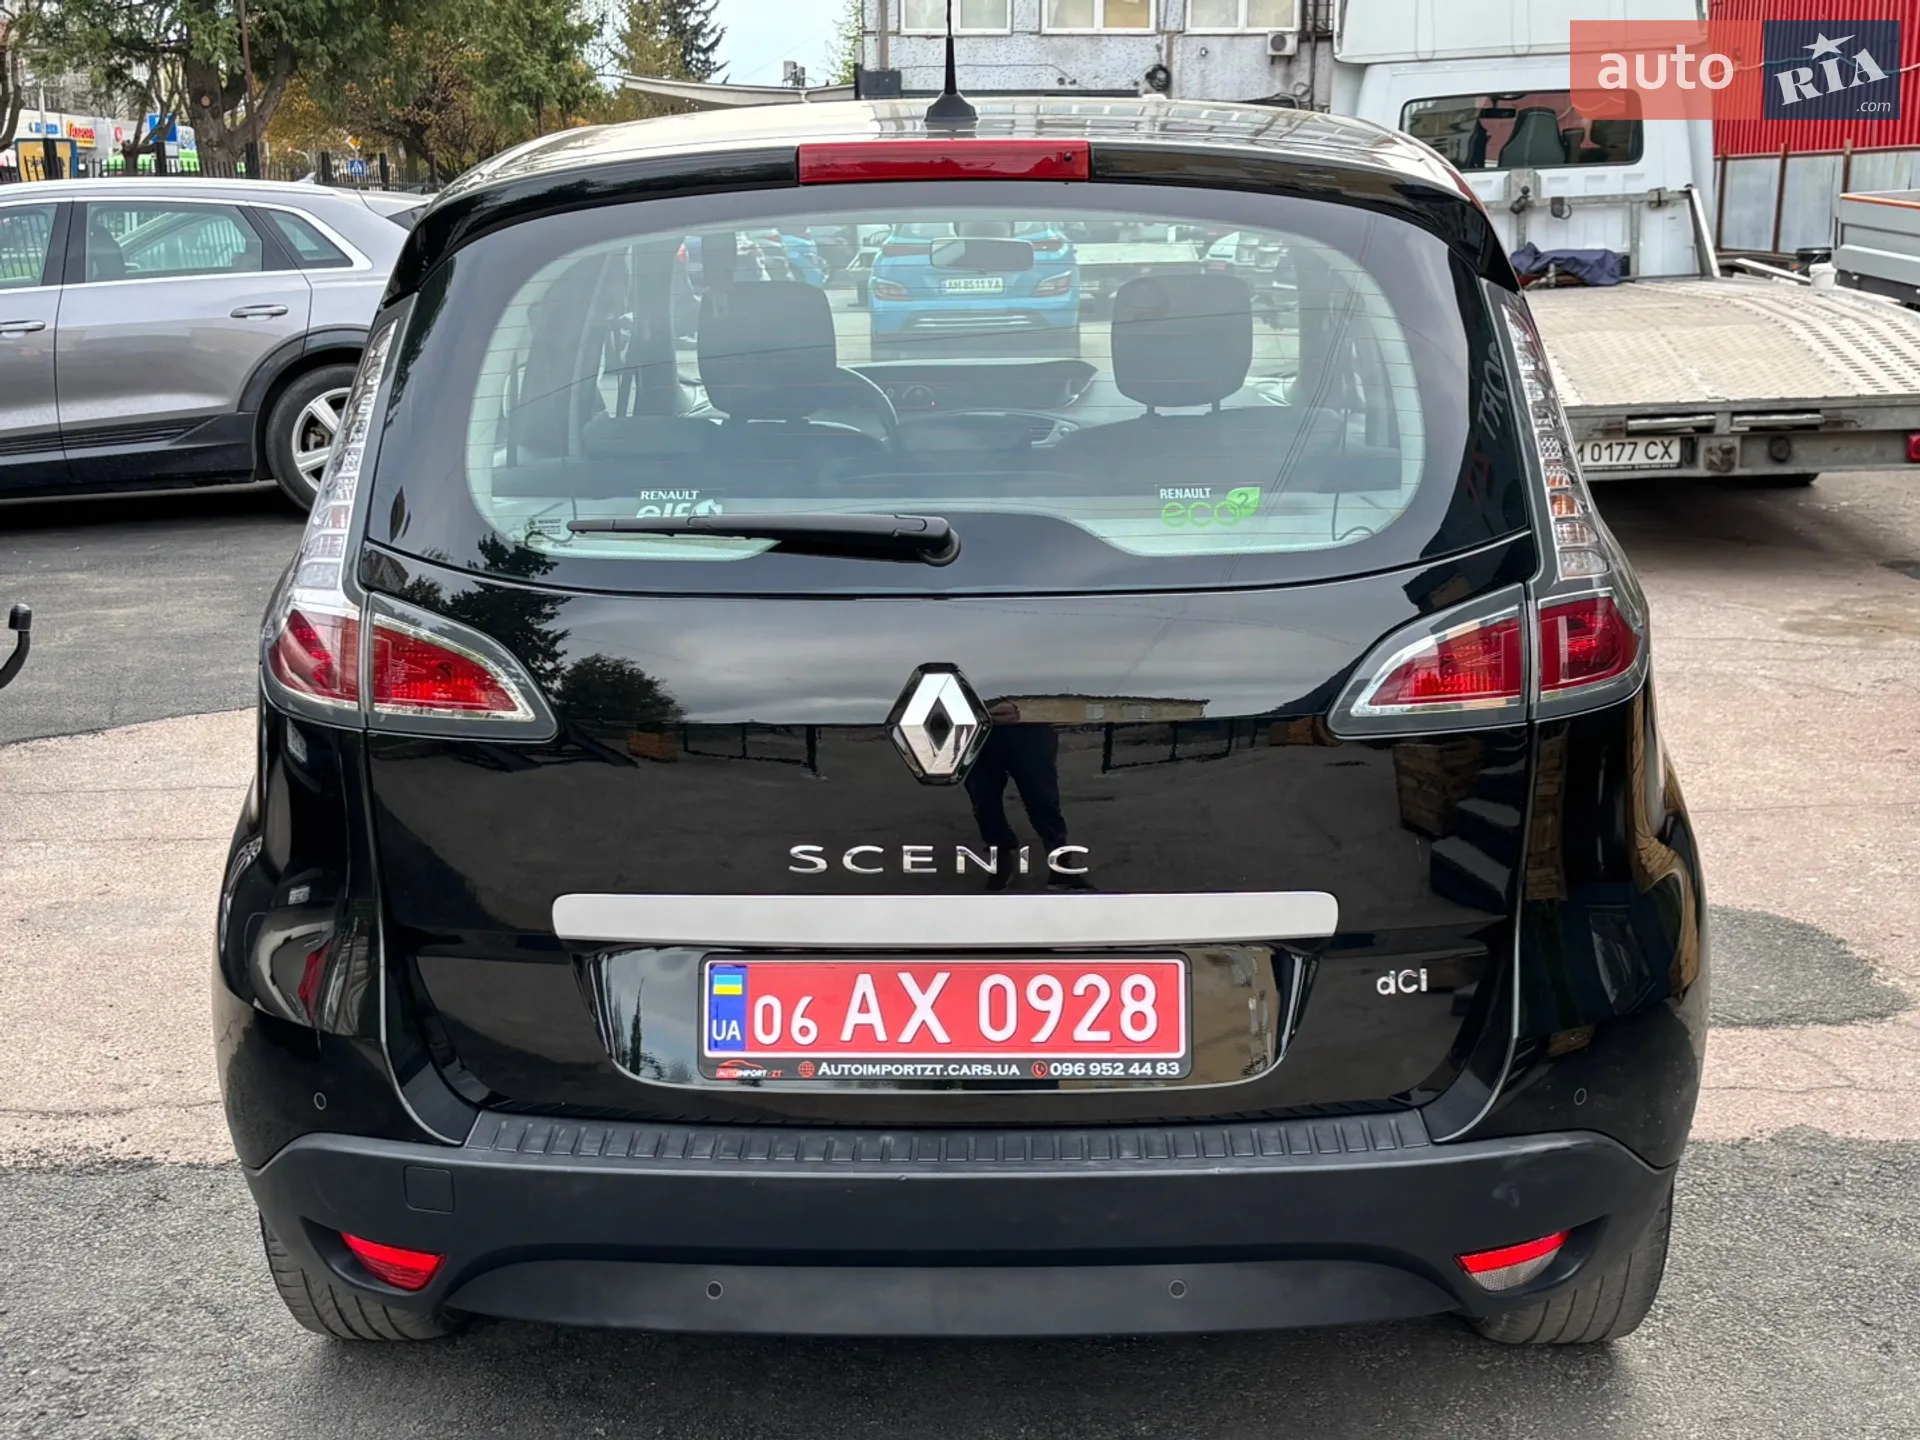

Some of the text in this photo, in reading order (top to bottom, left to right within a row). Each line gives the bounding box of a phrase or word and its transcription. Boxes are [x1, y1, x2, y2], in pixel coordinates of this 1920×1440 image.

[1590, 441, 1638, 462] 0177
[1644, 440, 1673, 460] CX
[640, 491, 699, 500] RENAULT
[1160, 488, 1211, 499] RENAULT
[789, 845, 1089, 874] SCENIC
[753, 971, 1158, 1046] 06 AX 0928
[712, 1020, 741, 1041] UA
[1050, 1061, 1180, 1076] 096 952 44 83
